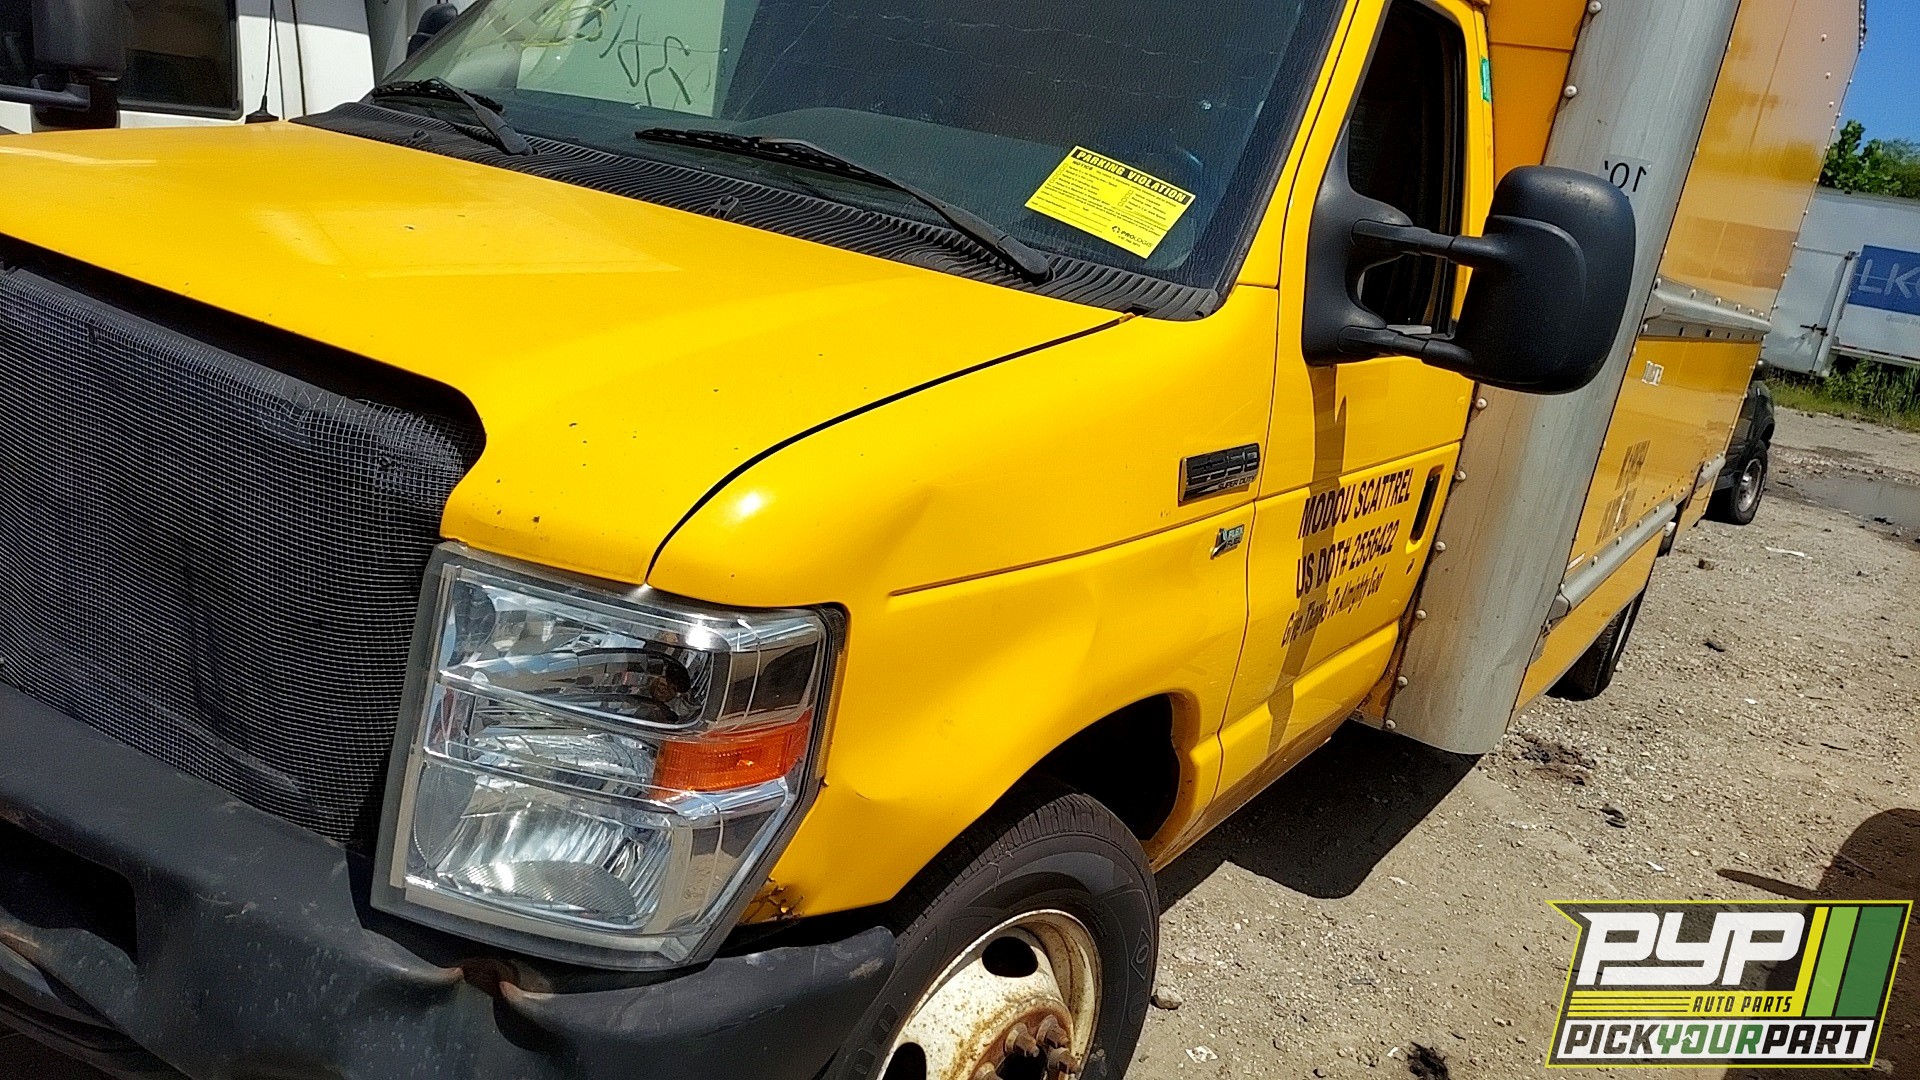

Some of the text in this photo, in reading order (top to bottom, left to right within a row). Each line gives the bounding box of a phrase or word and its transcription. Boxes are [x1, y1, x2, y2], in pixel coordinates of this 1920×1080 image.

[1072, 160, 1093, 171] NOTICE
[1076, 151, 1124, 175] PARKING
[1127, 170, 1186, 202] VIOLATION
[1120, 230, 1153, 248] PROLOGIS
[1858, 259, 1920, 299] LK
[1297, 468, 1414, 540] MODOU SCATTREL
[1296, 519, 1400, 599] US DOT# 2556422
